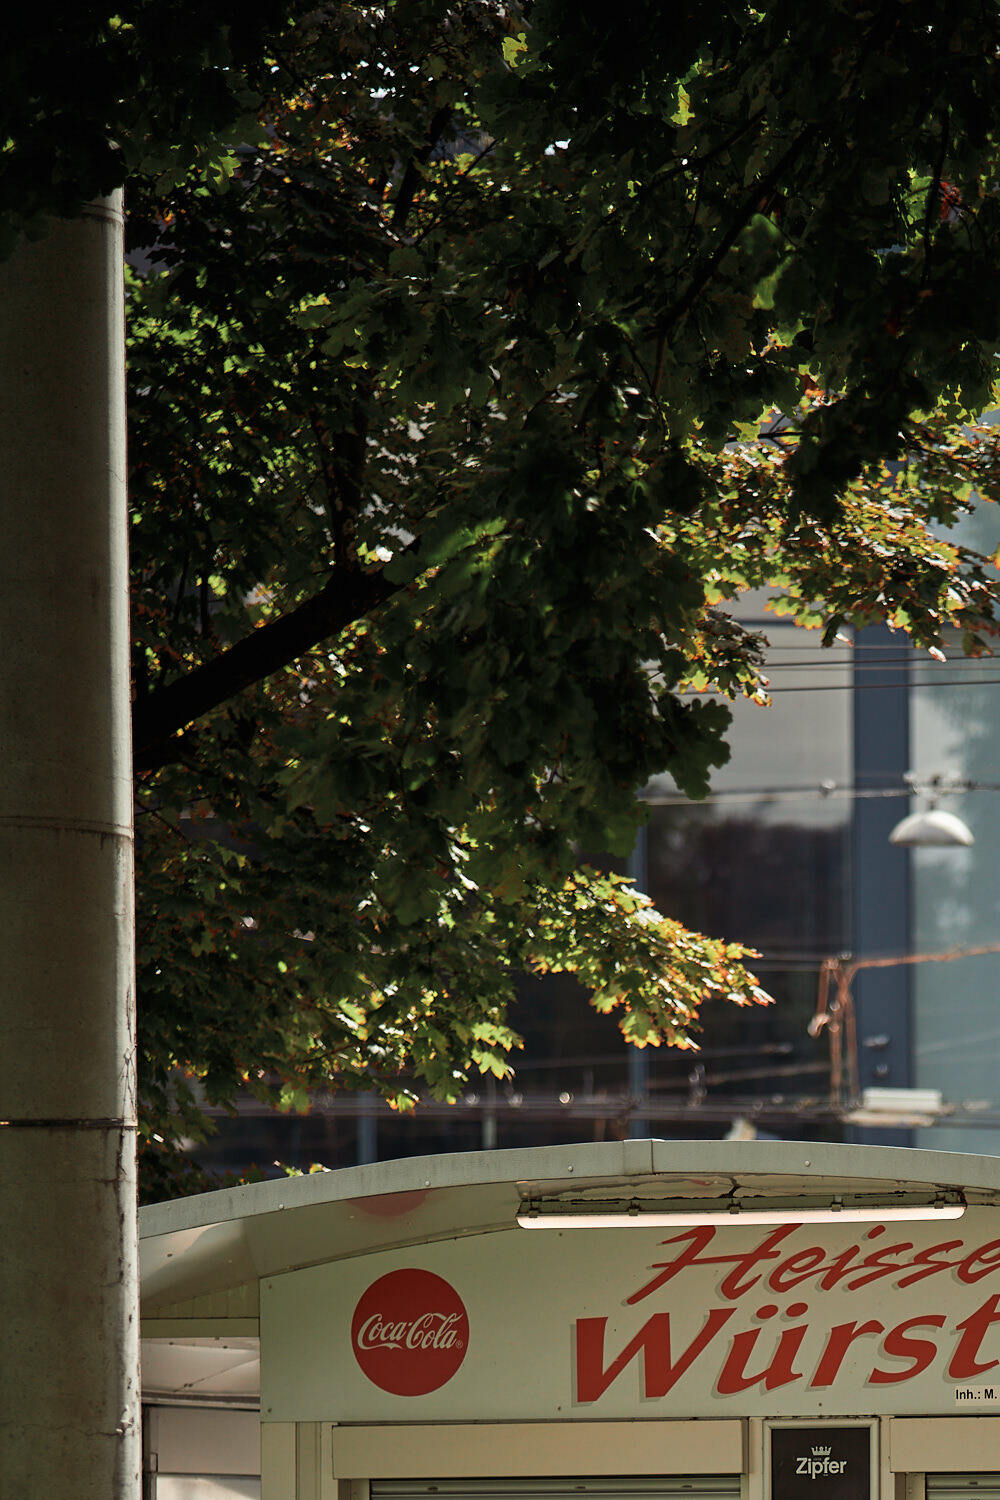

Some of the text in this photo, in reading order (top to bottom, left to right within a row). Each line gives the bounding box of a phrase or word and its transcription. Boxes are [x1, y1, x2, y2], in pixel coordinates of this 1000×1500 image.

[357, 1312, 464, 1351] Coca-Cola
[955, 1389, 981, 1400] Inh.:
[984, 1389, 998, 1400] M.
[796, 1457, 847, 1480] Zipfer
